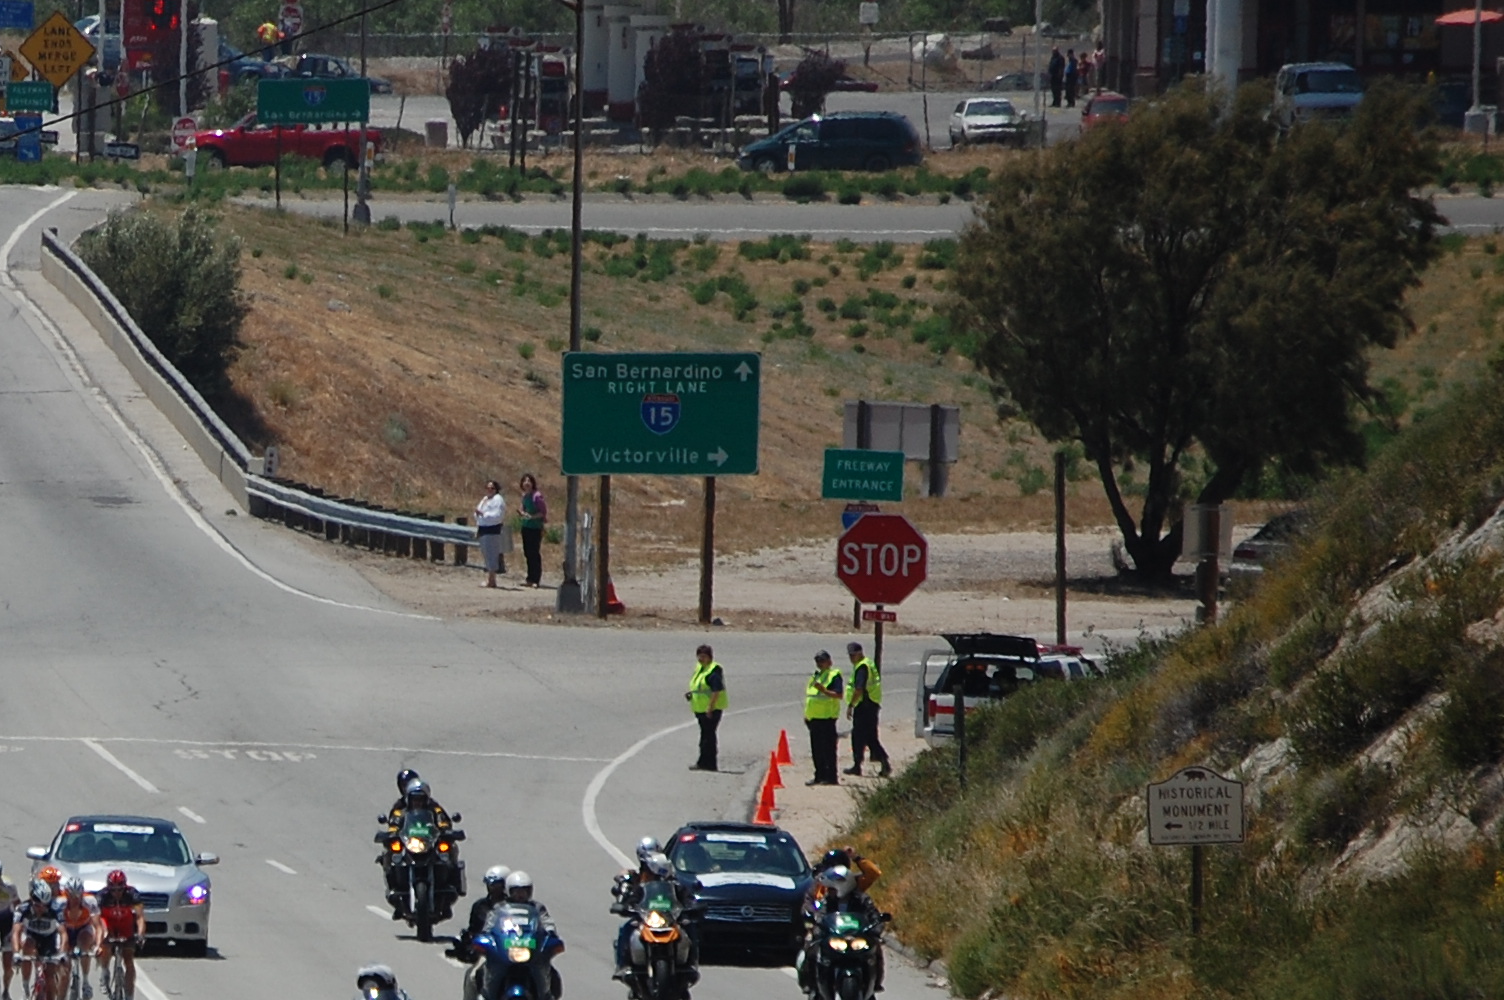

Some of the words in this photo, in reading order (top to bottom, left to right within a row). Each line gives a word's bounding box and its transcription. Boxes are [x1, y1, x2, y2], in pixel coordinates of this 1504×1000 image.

[38, 51, 77, 62] MERGE
[572, 363, 608, 379] San
[616, 362, 723, 379] Bernardino
[607, 381, 657, 394] RIGHT
[665, 381, 708, 394] LANE
[650, 406, 673, 426] 15
[591, 447, 700, 464] Victorville
[837, 459, 891, 473] FREEWAY
[832, 478, 895, 492] ENTRANCE
[842, 542, 922, 578] STOP
[1158, 787, 1232, 799] HISTORICAL
[1162, 804, 1230, 817] MONUMENT
